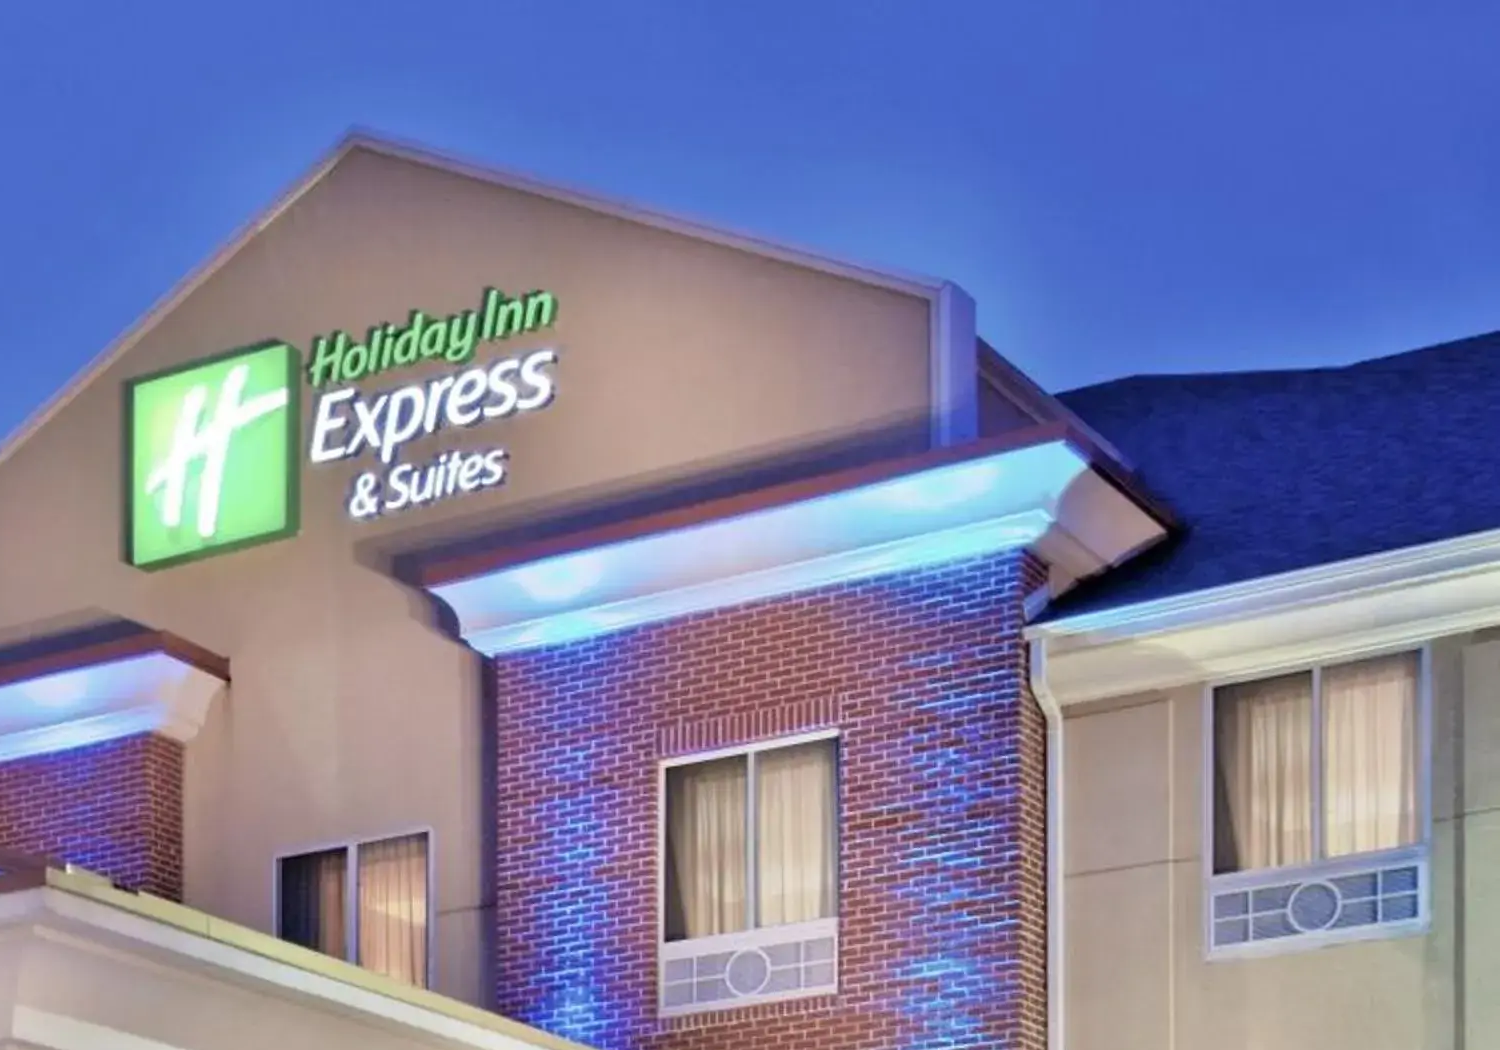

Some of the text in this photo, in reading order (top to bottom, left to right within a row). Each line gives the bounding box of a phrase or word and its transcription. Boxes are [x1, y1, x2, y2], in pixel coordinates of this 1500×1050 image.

[308, 288, 555, 387] Holiday Inn
[309, 350, 555, 463] Express
[349, 449, 505, 518] & Suites
